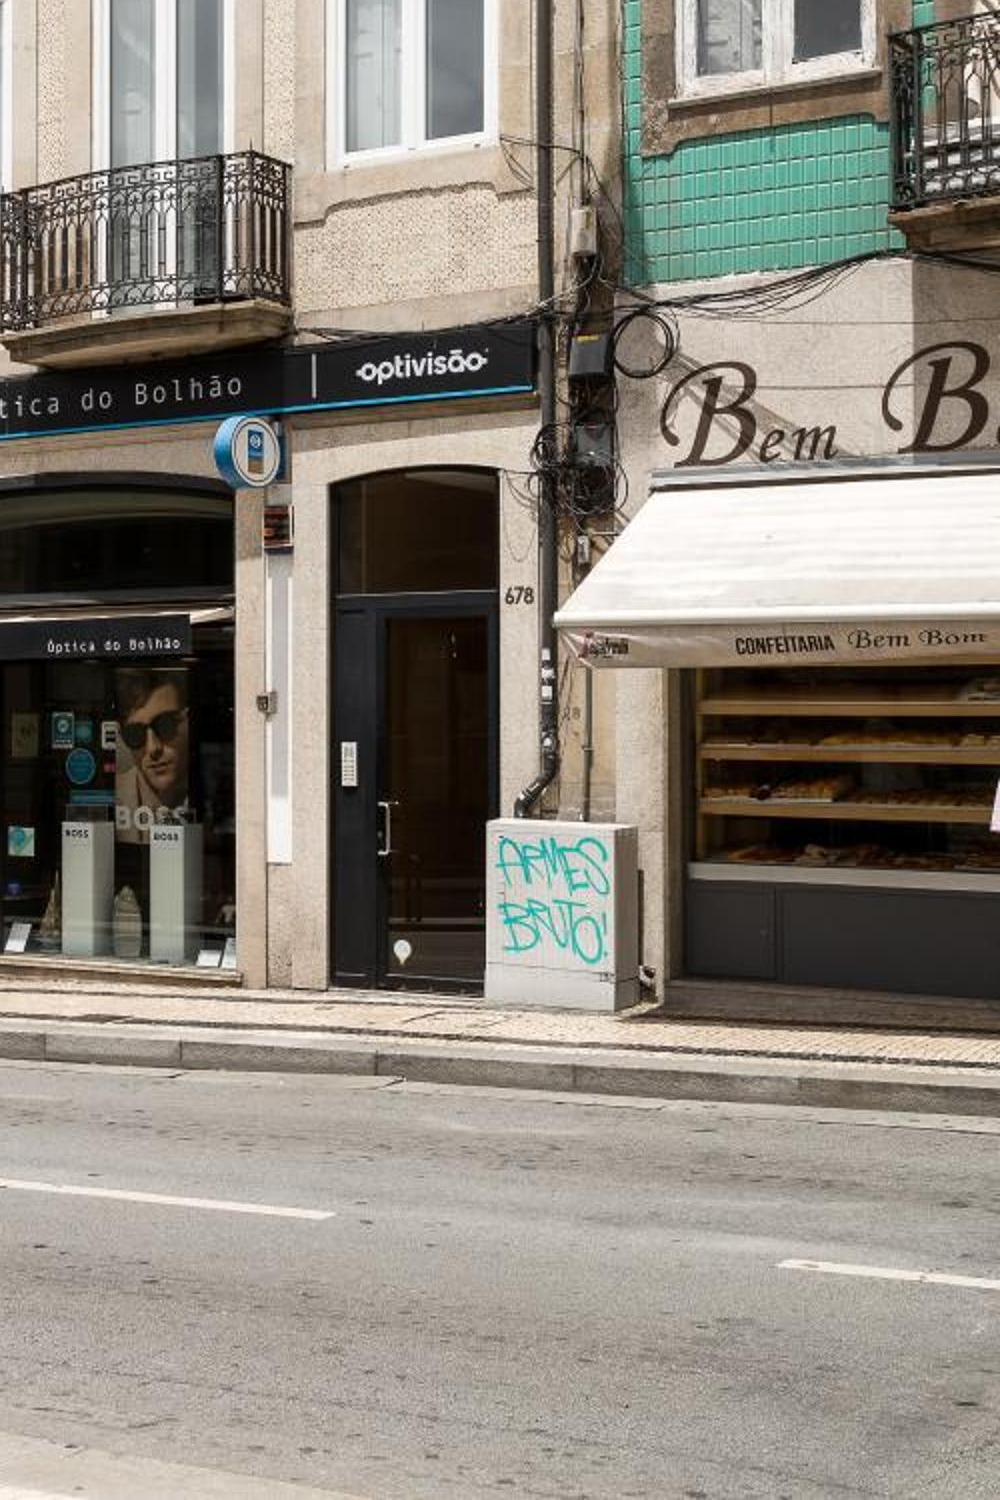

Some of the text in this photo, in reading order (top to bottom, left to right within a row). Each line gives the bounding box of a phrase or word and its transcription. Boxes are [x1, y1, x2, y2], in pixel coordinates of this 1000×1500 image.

[81, 388, 113, 412] do
[135, 375, 242, 405] Bolhão
[660, 341, 1000, 468] Bem B
[505, 585, 535, 605] 678
[47, 637, 181, 654] Óptica do Bolhão
[735, 629, 987, 655] CONFEITARIA Bem Bom
